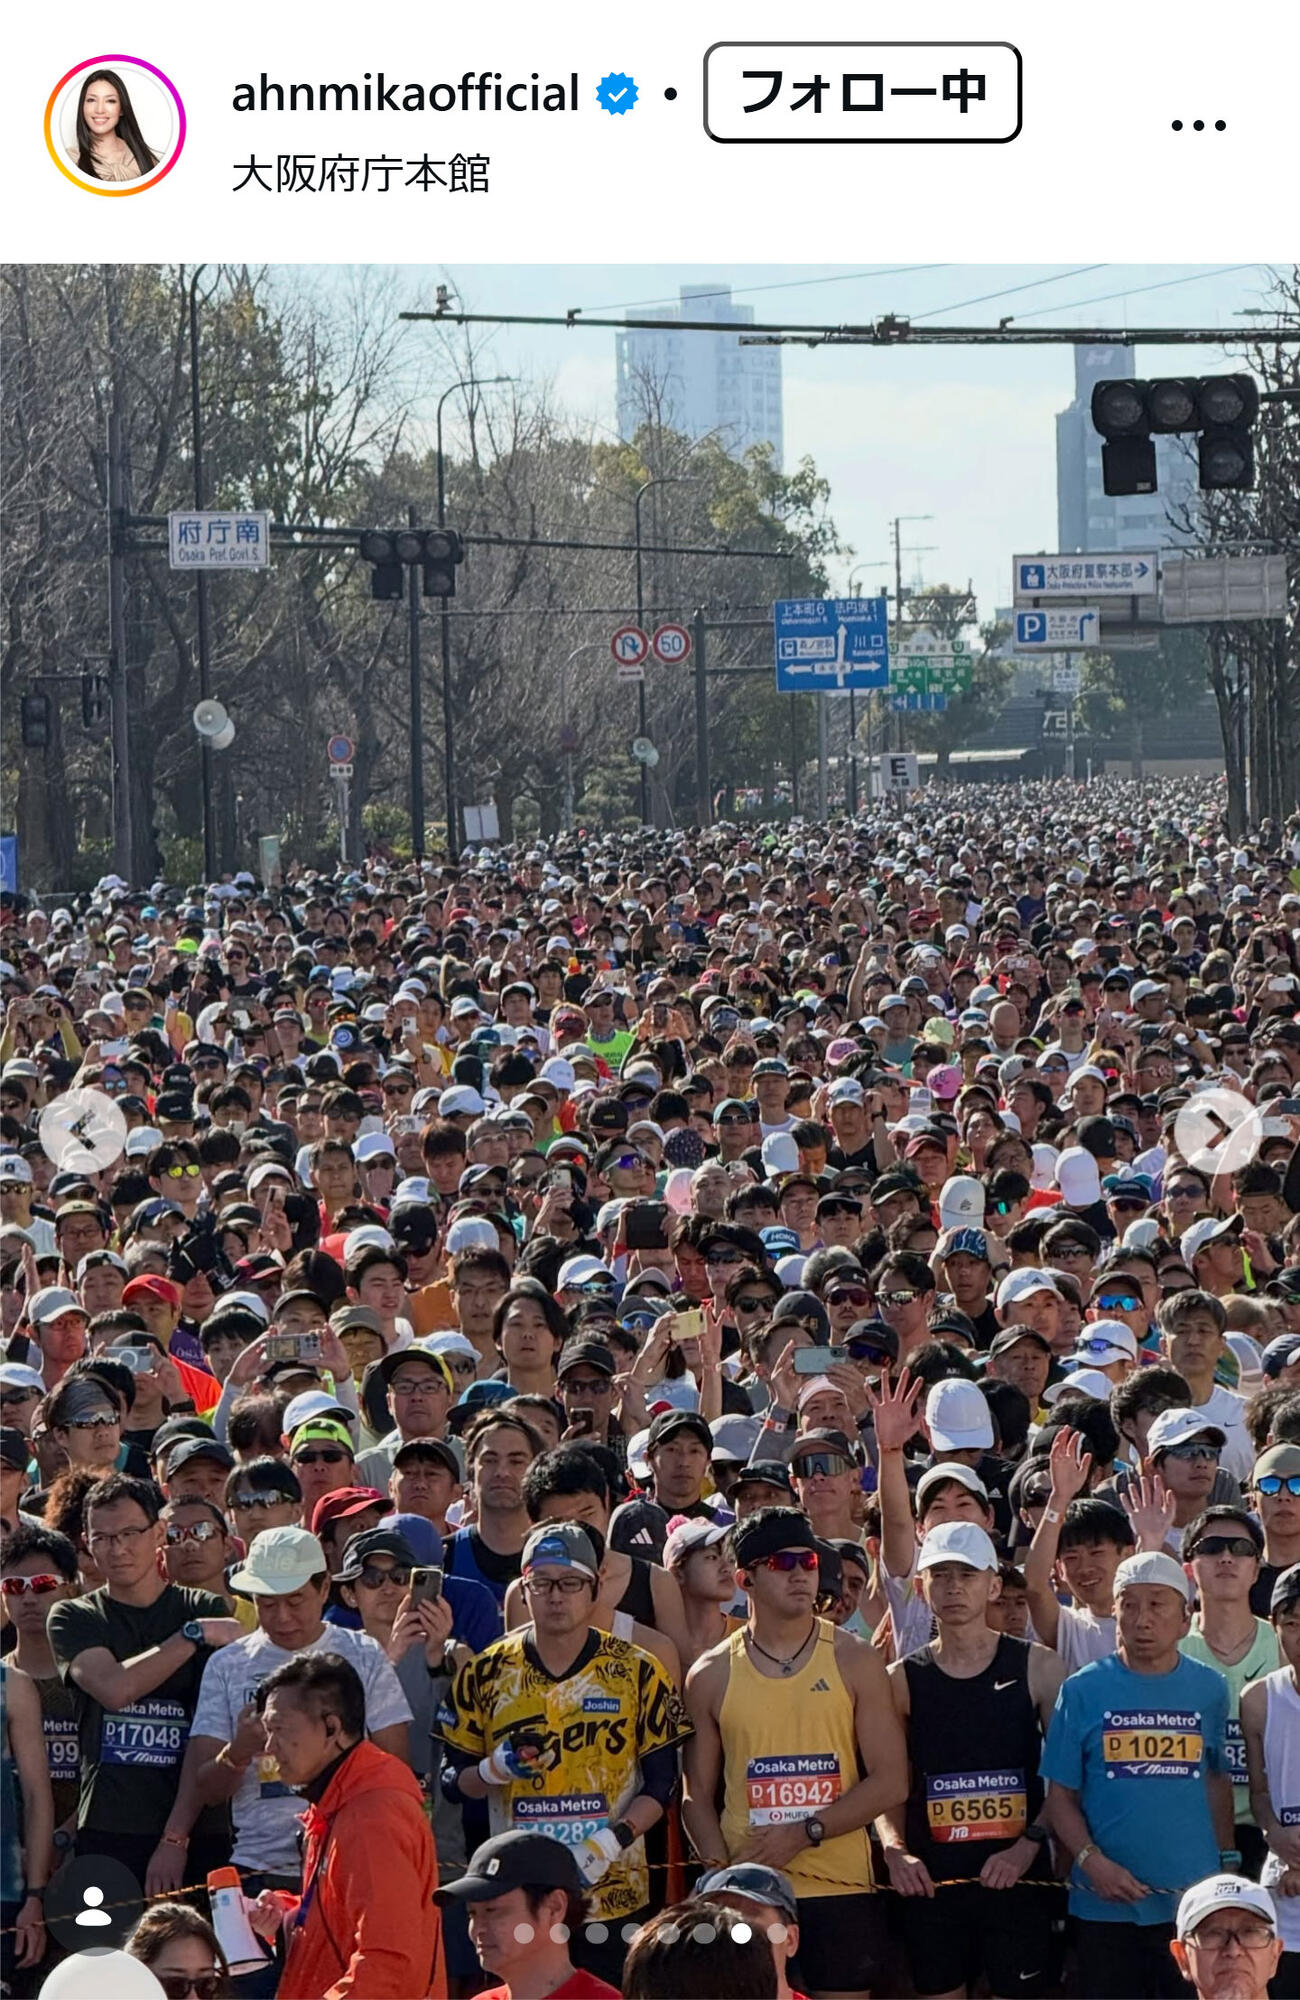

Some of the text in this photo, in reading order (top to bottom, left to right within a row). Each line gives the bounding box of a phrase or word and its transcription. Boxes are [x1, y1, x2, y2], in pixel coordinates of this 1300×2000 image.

[178, 518, 260, 545] 府庁南
[1021, 614, 1036, 640] P
[661, 634, 683, 653] 50
[853, 634, 884, 649] 川口
[890, 757, 908, 777] E
[771, 1231, 797, 1243] HOKA
[118, 1702, 186, 1718] saka Metro
[584, 1702, 620, 1713] Joshin
[1110, 1713, 1197, 1727] Osaka Metro
[1109, 1736, 1187, 1759] D 1021
[754, 1758, 836, 1774] Osaka Metro
[933, 1775, 1019, 1791] Osaka Metro
[517, 1799, 601, 1813] Osaka Metro
[932, 1796, 1014, 1822] D 6565
[784, 1811, 810, 1820] MUFG
[948, 1826, 969, 1842] JTB
